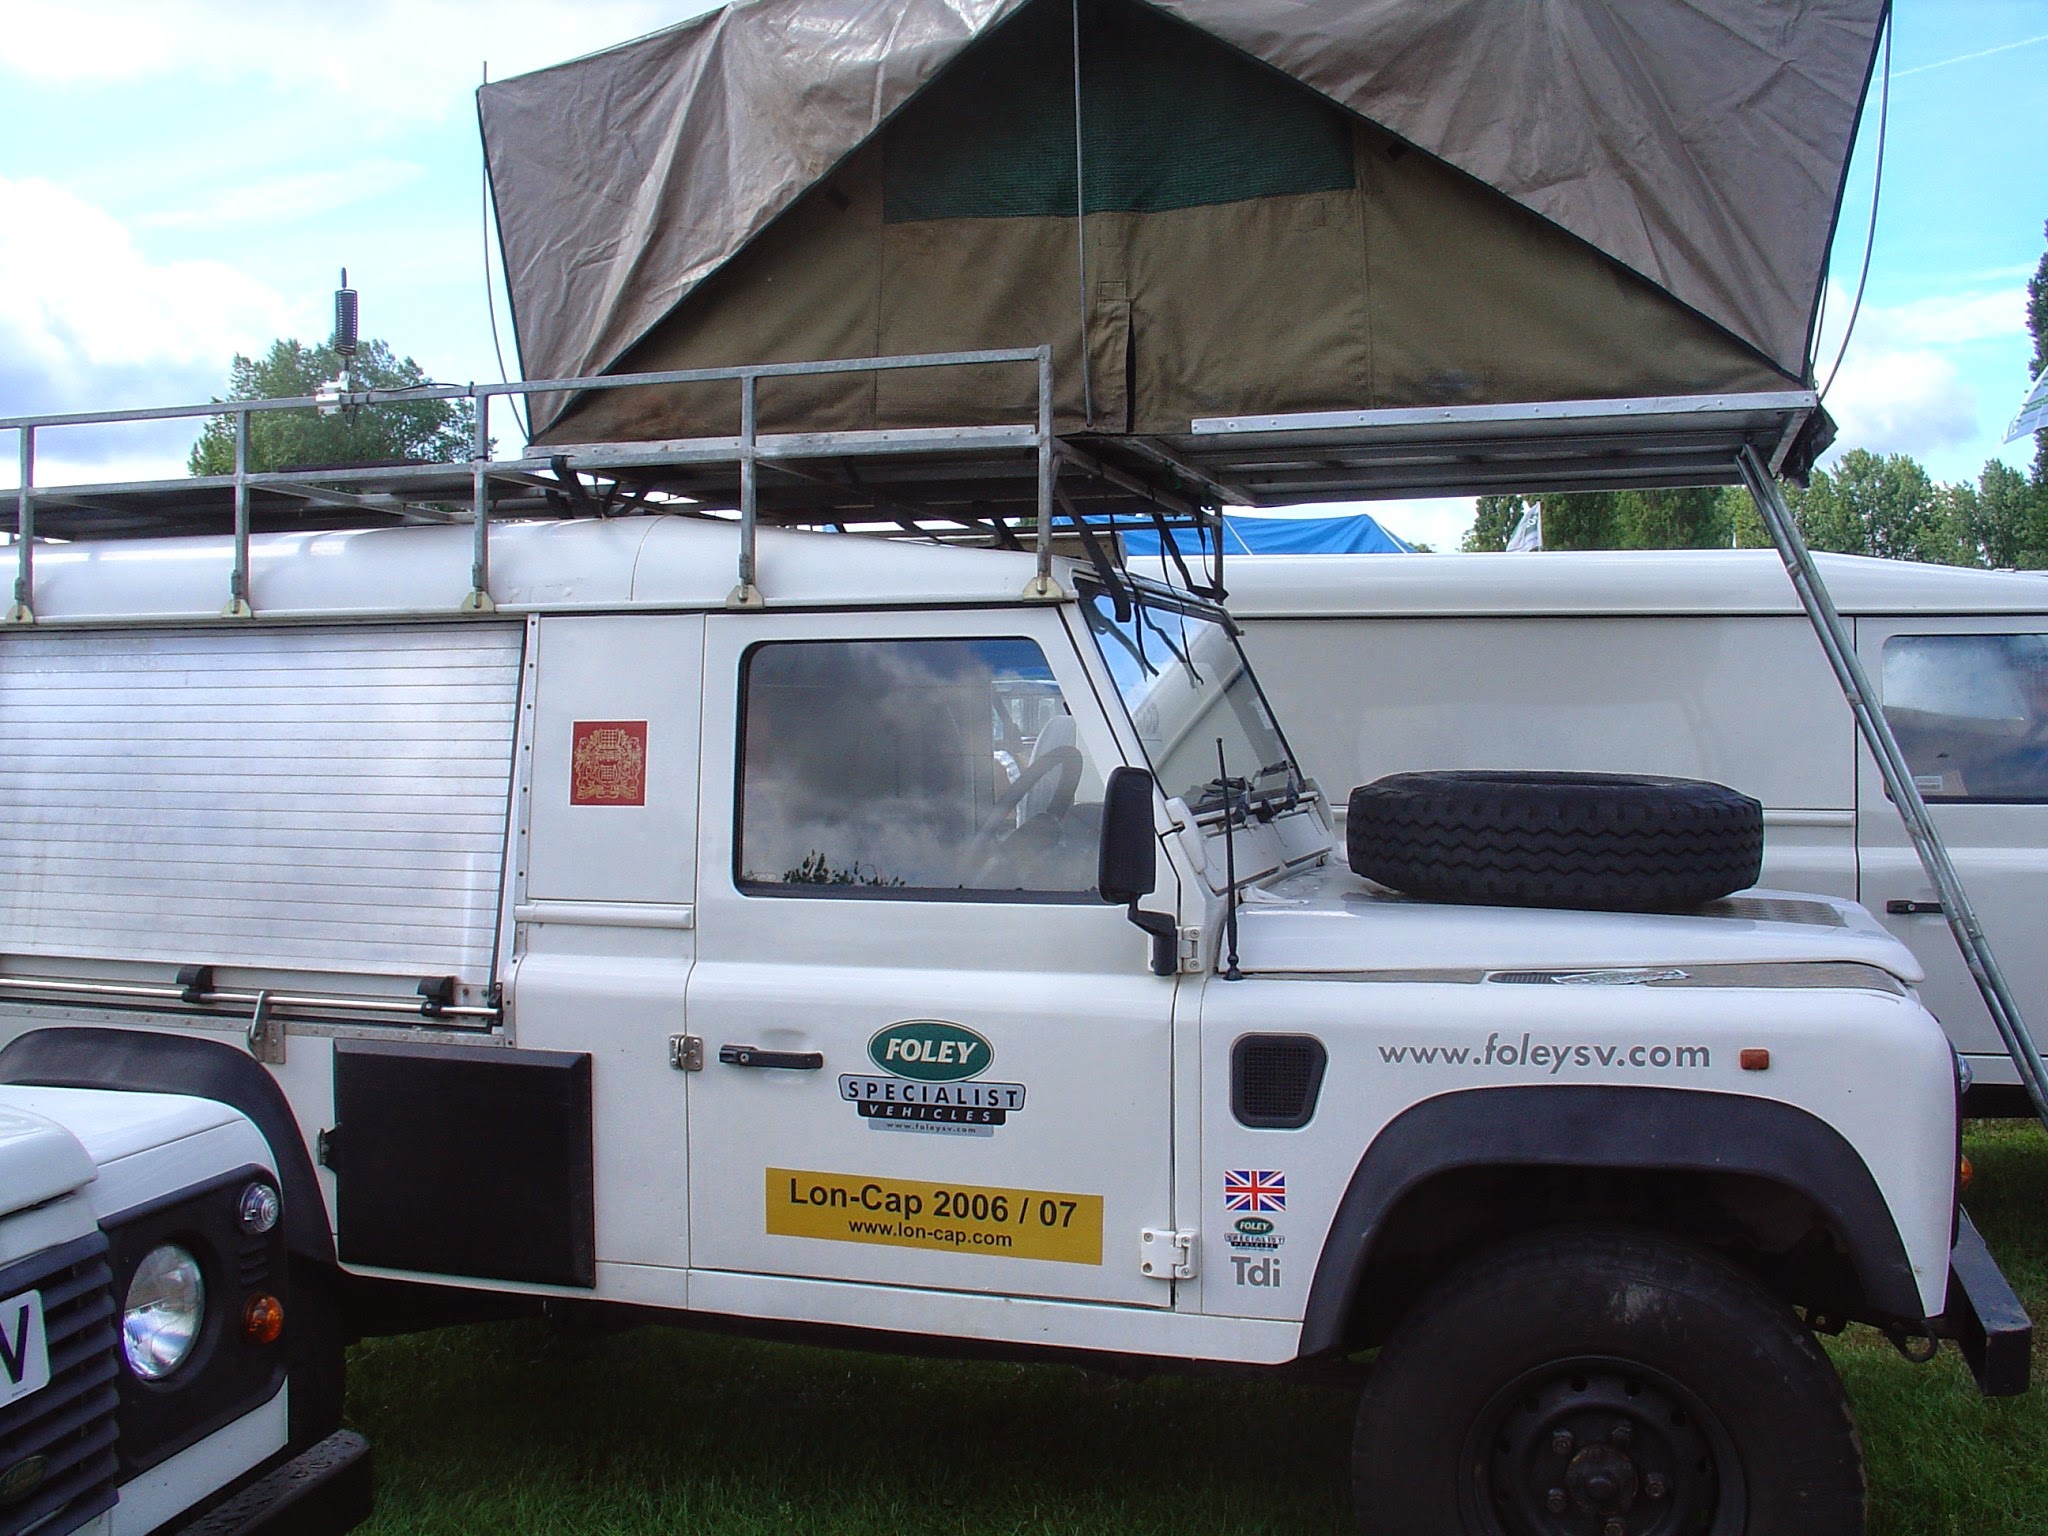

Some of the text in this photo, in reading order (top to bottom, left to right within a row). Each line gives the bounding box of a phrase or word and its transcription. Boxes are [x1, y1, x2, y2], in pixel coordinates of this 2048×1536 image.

[886, 1038, 977, 1064] FOLEY
[1378, 1032, 1711, 1074] www.foleysv.com
[848, 1081, 1018, 1107] SPECIALIST
[868, 1104, 991, 1121] VEHICLES
[790, 1177, 923, 1220] Lon-Cap
[933, 1190, 1009, 1223] 2006
[1038, 1199, 1078, 1228] 07
[848, 1220, 1013, 1247] www.lon-cap.com
[1240, 1221, 1269, 1231] FOLEY
[1230, 1256, 1280, 1287] Tdi
